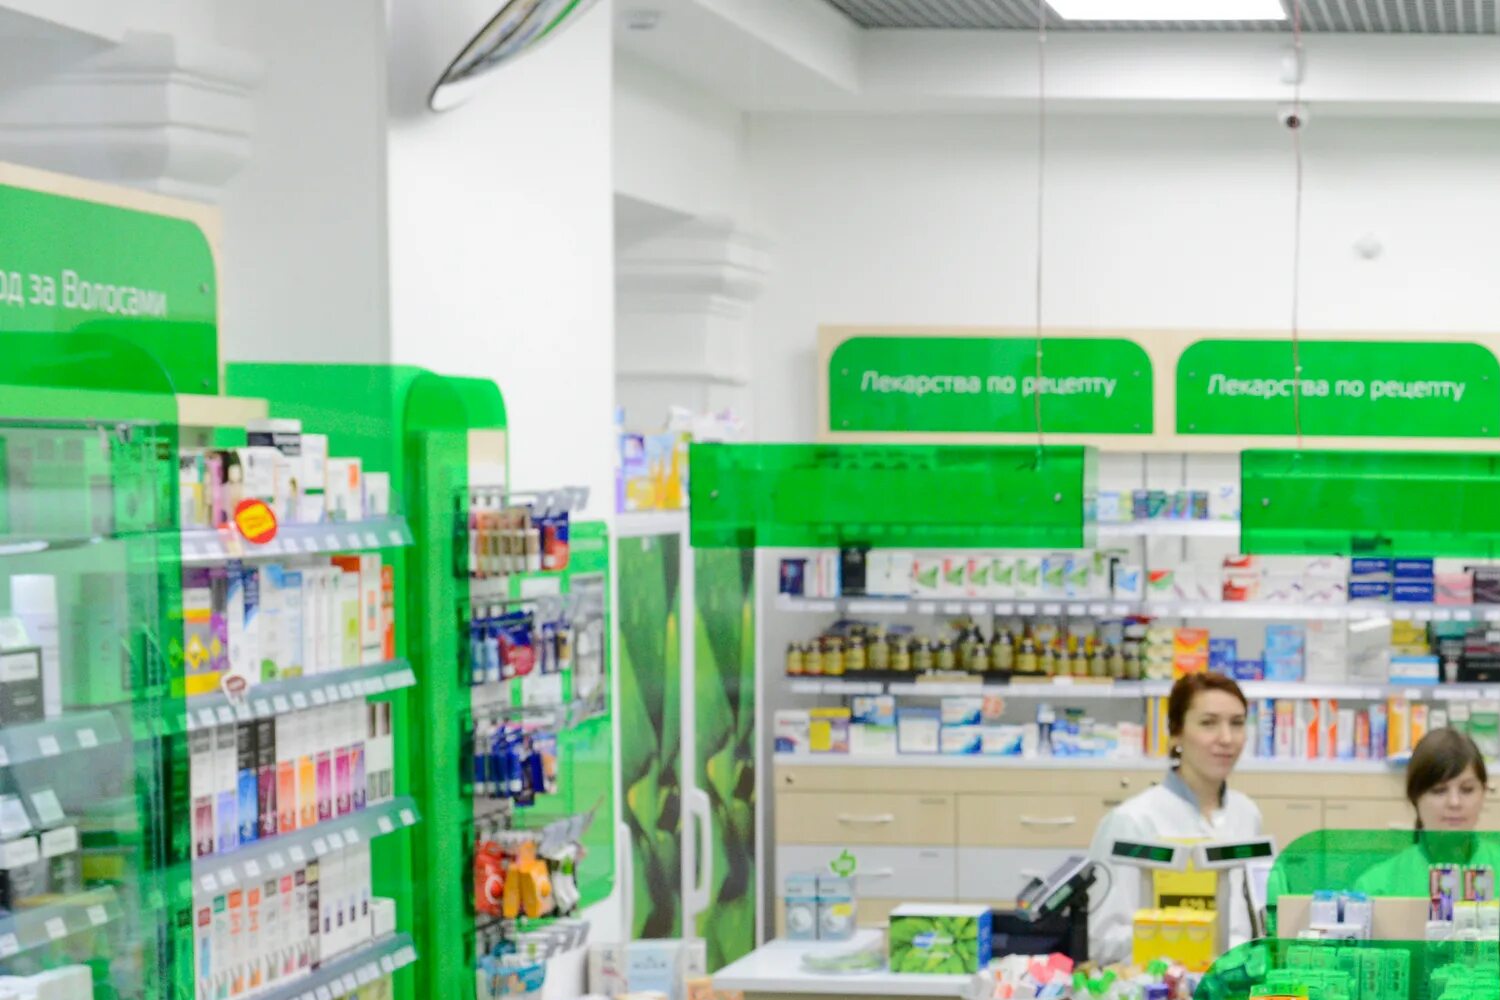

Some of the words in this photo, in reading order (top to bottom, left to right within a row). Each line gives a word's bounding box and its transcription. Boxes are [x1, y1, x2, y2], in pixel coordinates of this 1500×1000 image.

[0, 271, 25, 308] од
[29, 273, 56, 306] за
[62, 269, 167, 317] Волосами
[861, 371, 981, 397] Лекарства
[987, 376, 1016, 395] по
[1022, 376, 1117, 398] рецепту
[1208, 374, 1329, 399] Лекарства
[1335, 380, 1365, 397] по
[1370, 380, 1465, 402] рецепту
